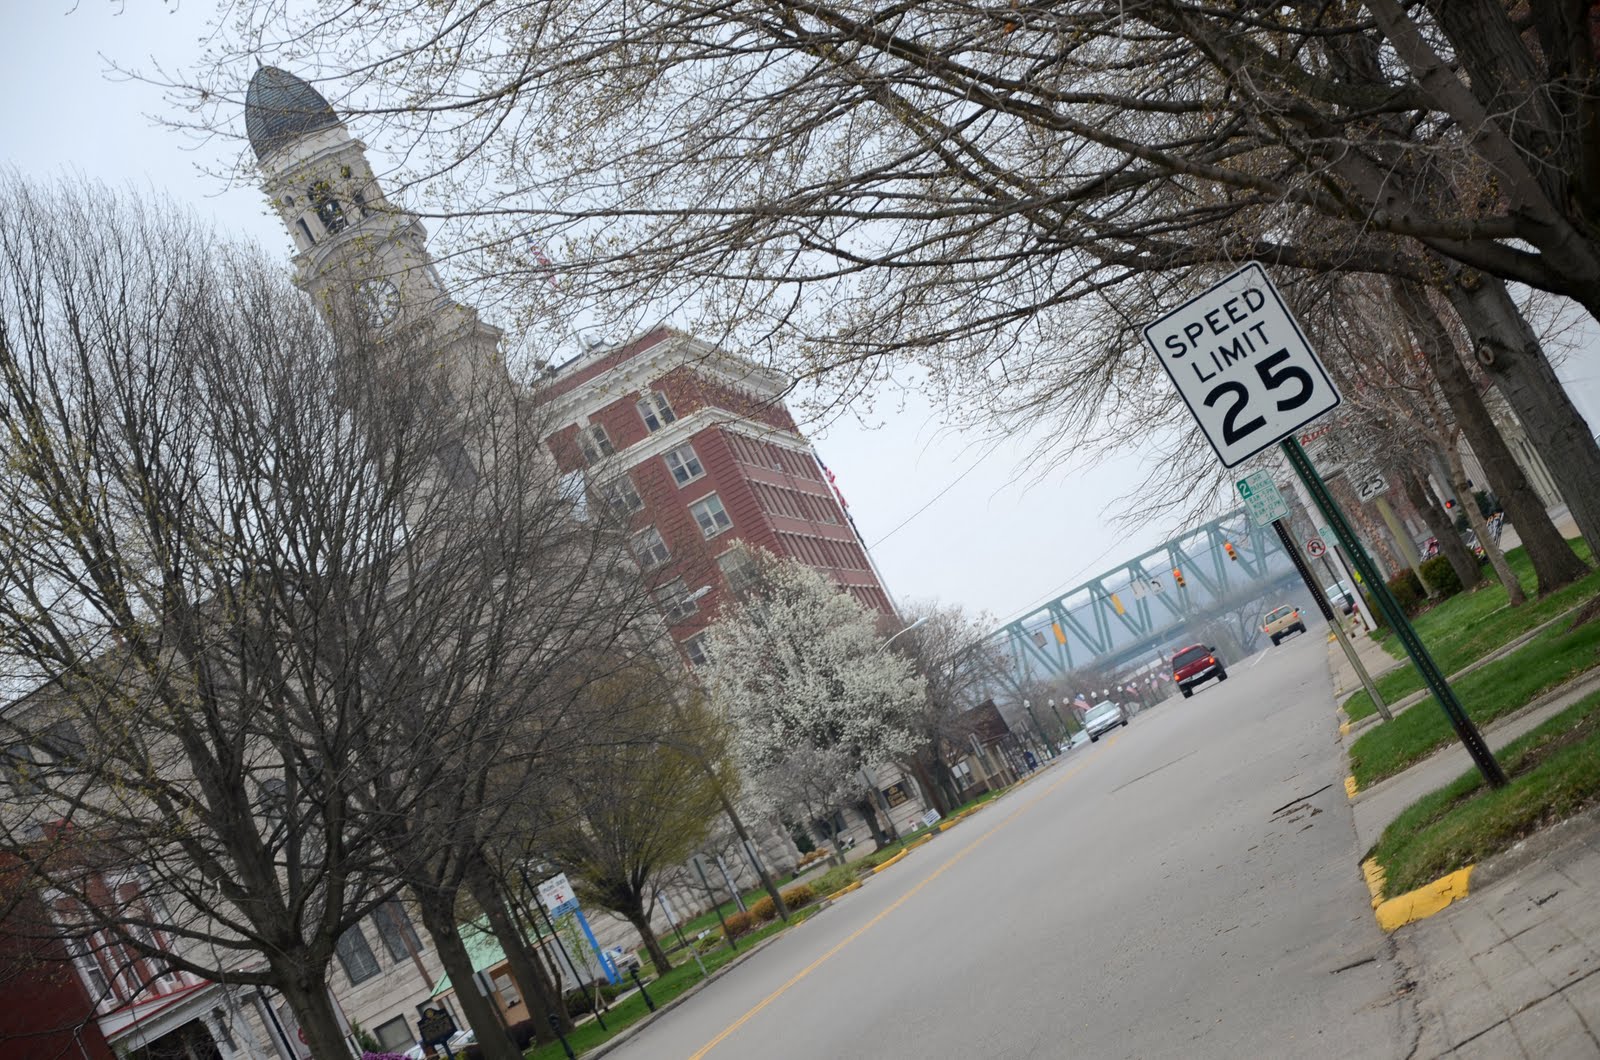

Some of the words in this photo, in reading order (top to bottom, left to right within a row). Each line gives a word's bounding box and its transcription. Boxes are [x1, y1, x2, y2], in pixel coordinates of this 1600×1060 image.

[1165, 288, 1265, 358] SPEED
[1192, 321, 1269, 383] LIMIT
[1203, 347, 1314, 447] 25
[1239, 483, 1250, 497] 2
[1356, 475, 1384, 497] 25
